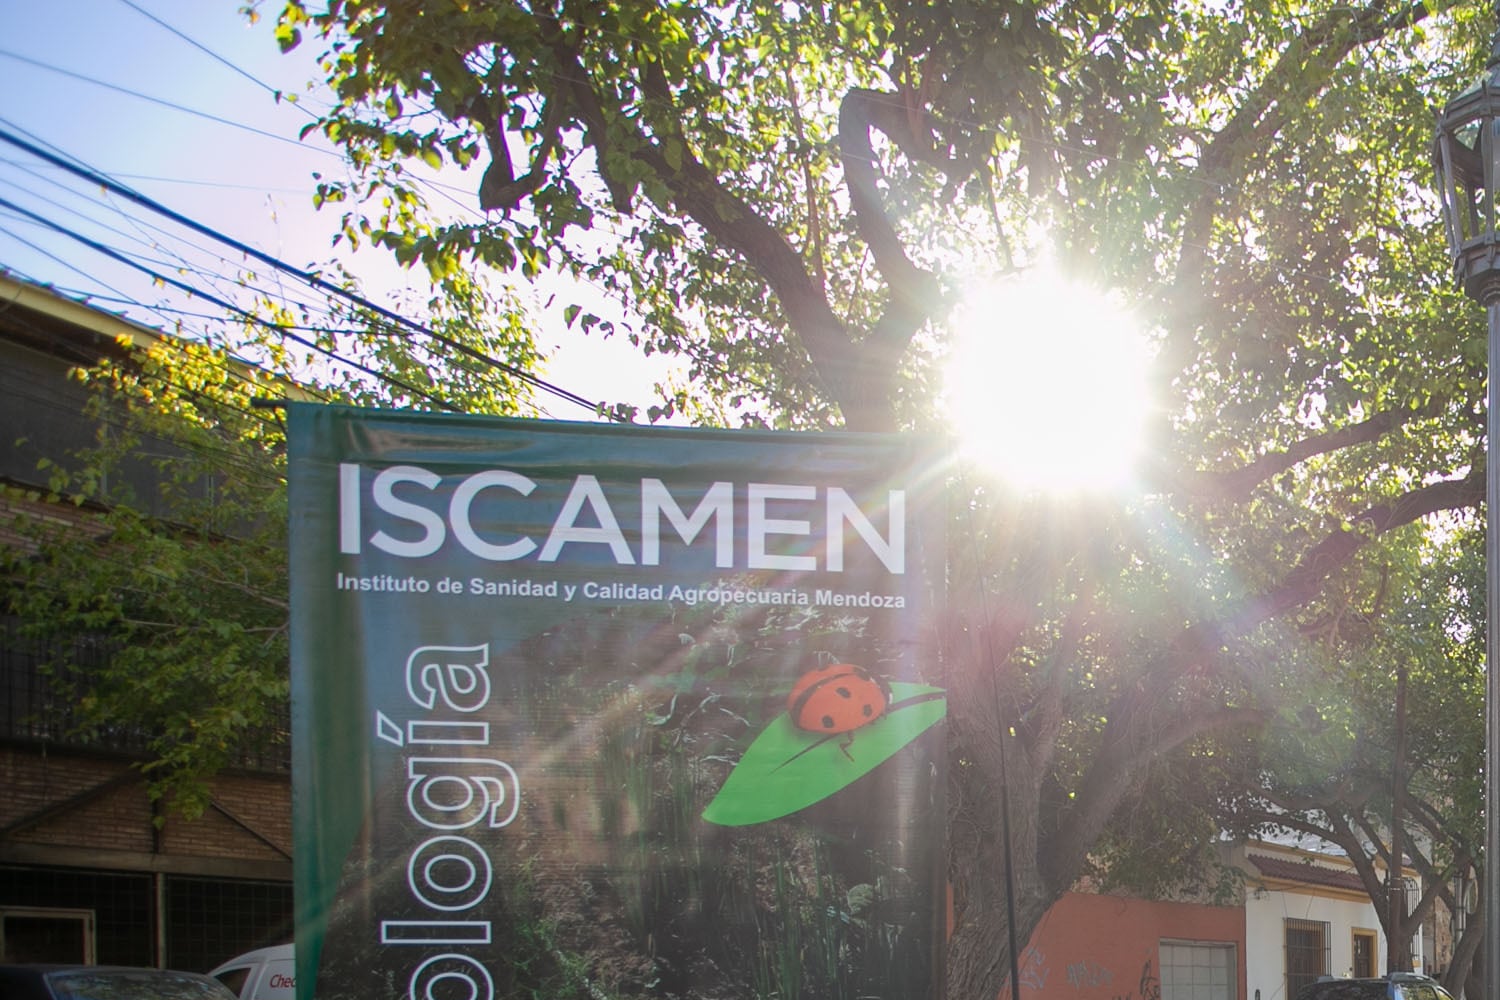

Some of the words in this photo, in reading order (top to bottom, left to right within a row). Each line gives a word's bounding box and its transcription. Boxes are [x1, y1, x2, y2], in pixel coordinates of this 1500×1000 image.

[338, 462, 906, 575] ISCAMEN
[337, 572, 430, 593] Instituto
[436, 577, 463, 594] de
[469, 578, 558, 598] Sanidad
[563, 583, 577, 602] y
[583, 581, 664, 600] Calidad
[668, 585, 809, 606] Agropecuaria
[815, 589, 906, 609] Mendoza
